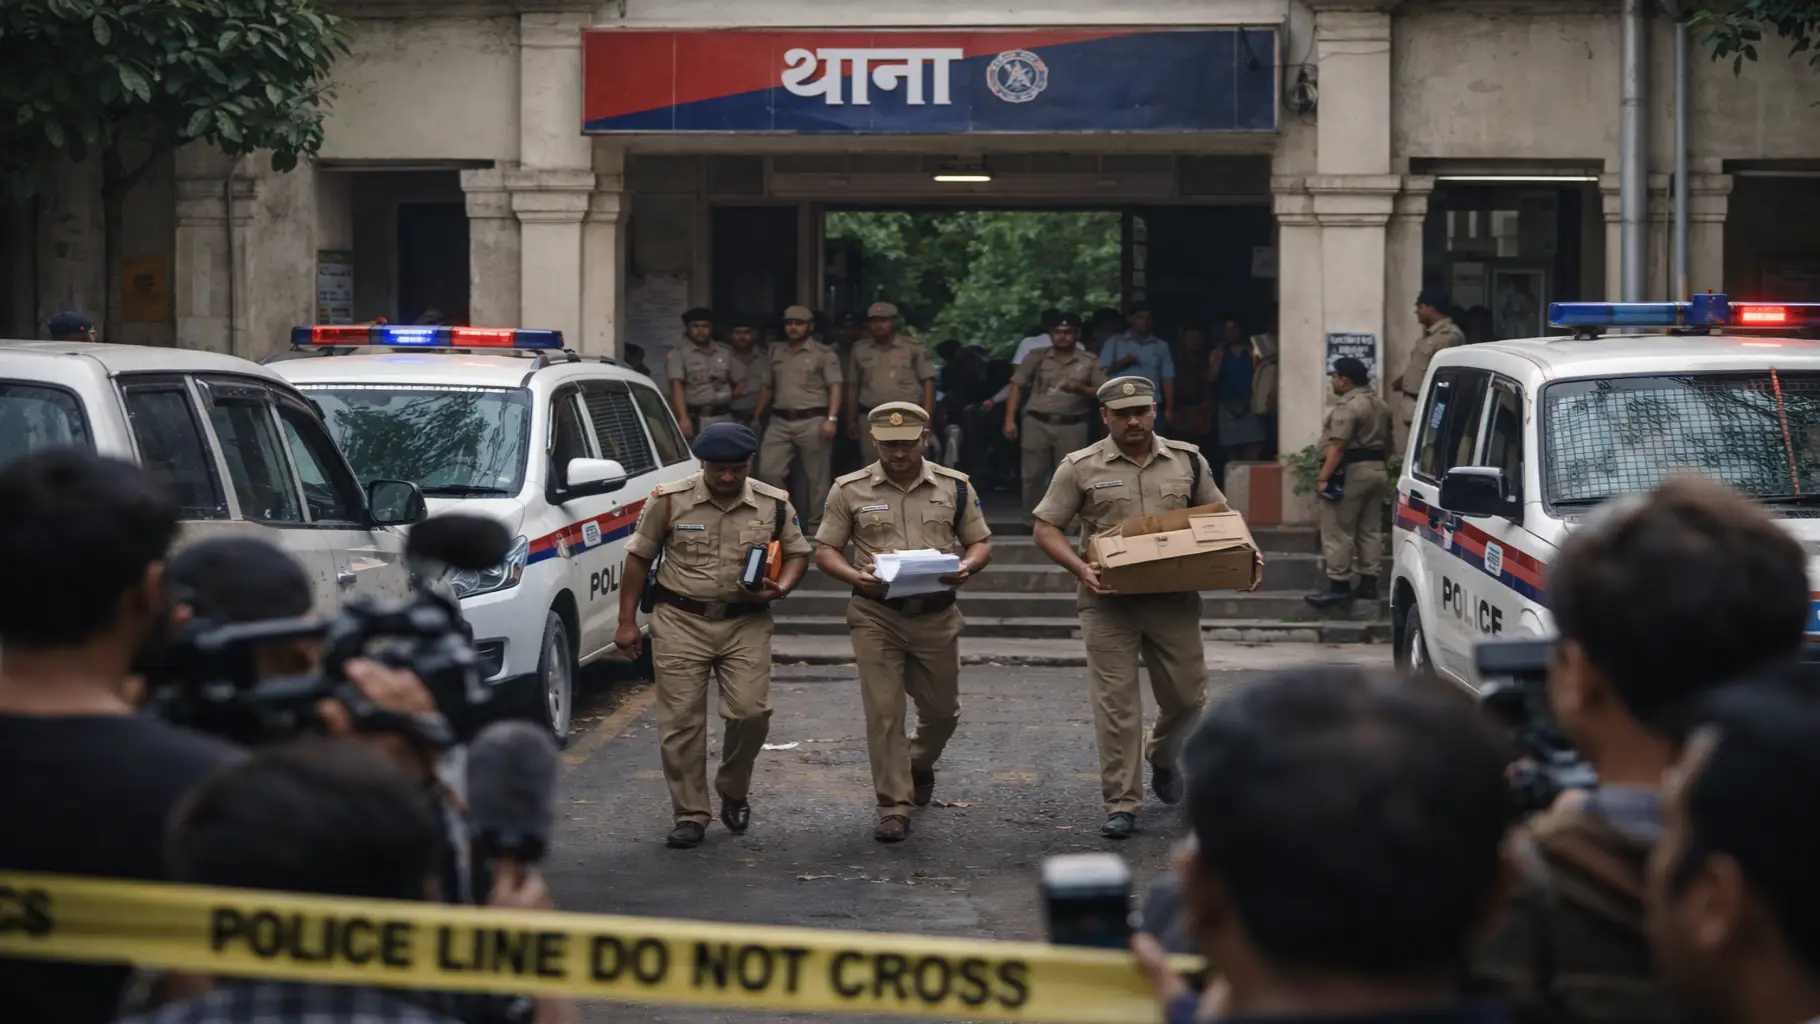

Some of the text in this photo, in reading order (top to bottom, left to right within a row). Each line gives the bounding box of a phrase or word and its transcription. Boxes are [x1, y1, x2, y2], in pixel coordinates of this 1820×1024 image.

[781, 48, 963, 105] थाना
[1443, 576, 1502, 635] POLICE
[211, 907, 1030, 1010] POLICE LINE DO NOT CROSS
